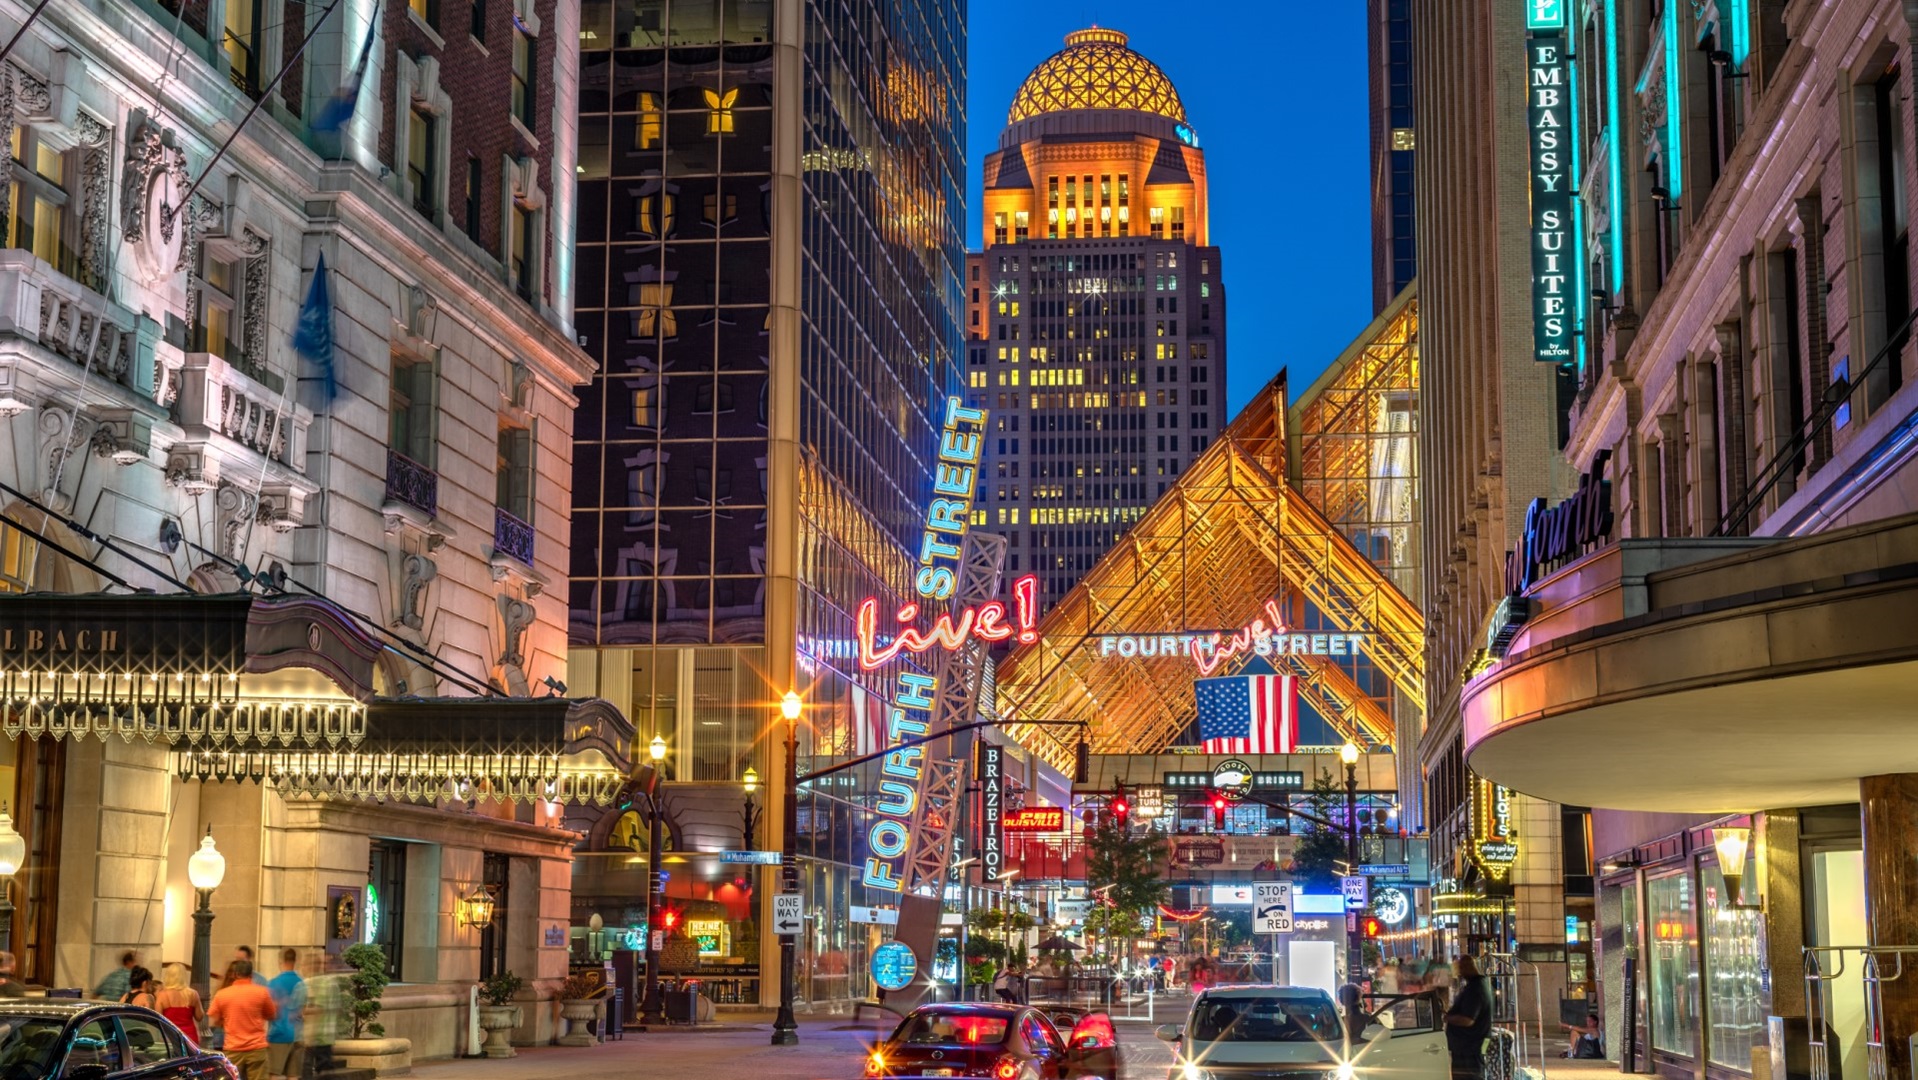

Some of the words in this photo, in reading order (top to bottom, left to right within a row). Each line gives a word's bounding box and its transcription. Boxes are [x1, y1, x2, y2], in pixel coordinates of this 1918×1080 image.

[1532, 46, 1562, 192] EMBASSY
[1538, 210, 1565, 337] SUITES
[1549, 343, 1560, 351] by
[1520, 449, 1613, 592] fourth
[857, 573, 1038, 671] Live!
[1191, 600, 1286, 675] Live!
[863, 672, 938, 892] FOURTH
[916, 396, 988, 600] STREET
[1101, 635, 1216, 657] FOURTH
[1254, 634, 1364, 657] STREET
[1220, 762, 1246, 772] GOOSE
[1169, 776, 1207, 785] BEER
[1257, 776, 1301, 785] BRIDGE
[1139, 790, 1161, 798] LEFT
[985, 750, 999, 880] BRAZEIROS
[1003, 819, 1062, 827] OUISVILLE
[1258, 886, 1287, 896] STOP
[778, 898, 799, 907] ONE
[777, 909, 799, 918] WAY
[692, 921, 720, 930] HEINE
[1267, 919, 1289, 929] RED
